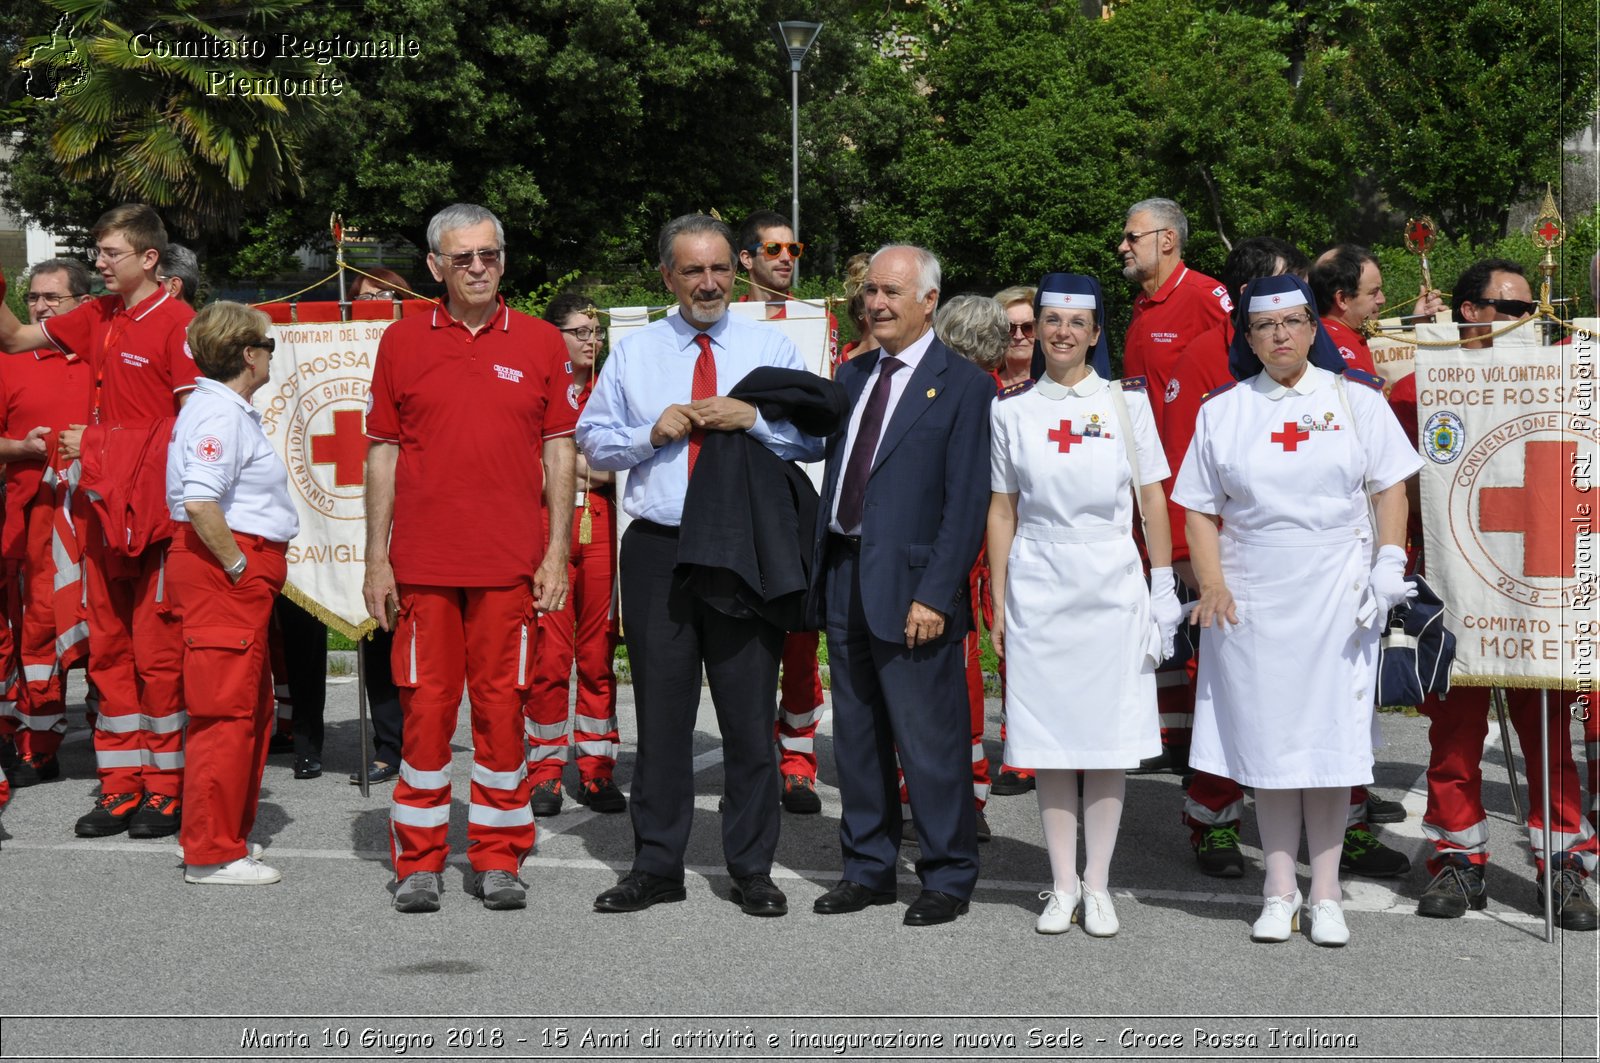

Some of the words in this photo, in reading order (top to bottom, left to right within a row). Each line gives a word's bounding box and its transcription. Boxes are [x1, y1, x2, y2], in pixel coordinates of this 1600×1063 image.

[340, 328, 358, 342] DEL
[1427, 367, 1475, 384] CORPO
[1482, 365, 1561, 383] VOLONTARI
[261, 372, 299, 436] CROCE
[298, 351, 371, 380] ROSSA
[303, 394, 319, 412] DI
[1419, 388, 1495, 406] CROCE
[1503, 386, 1584, 405] ROSSA
[1458, 414, 1558, 488] CONVENZIONE
[1463, 615, 1551, 633] COMITATO
